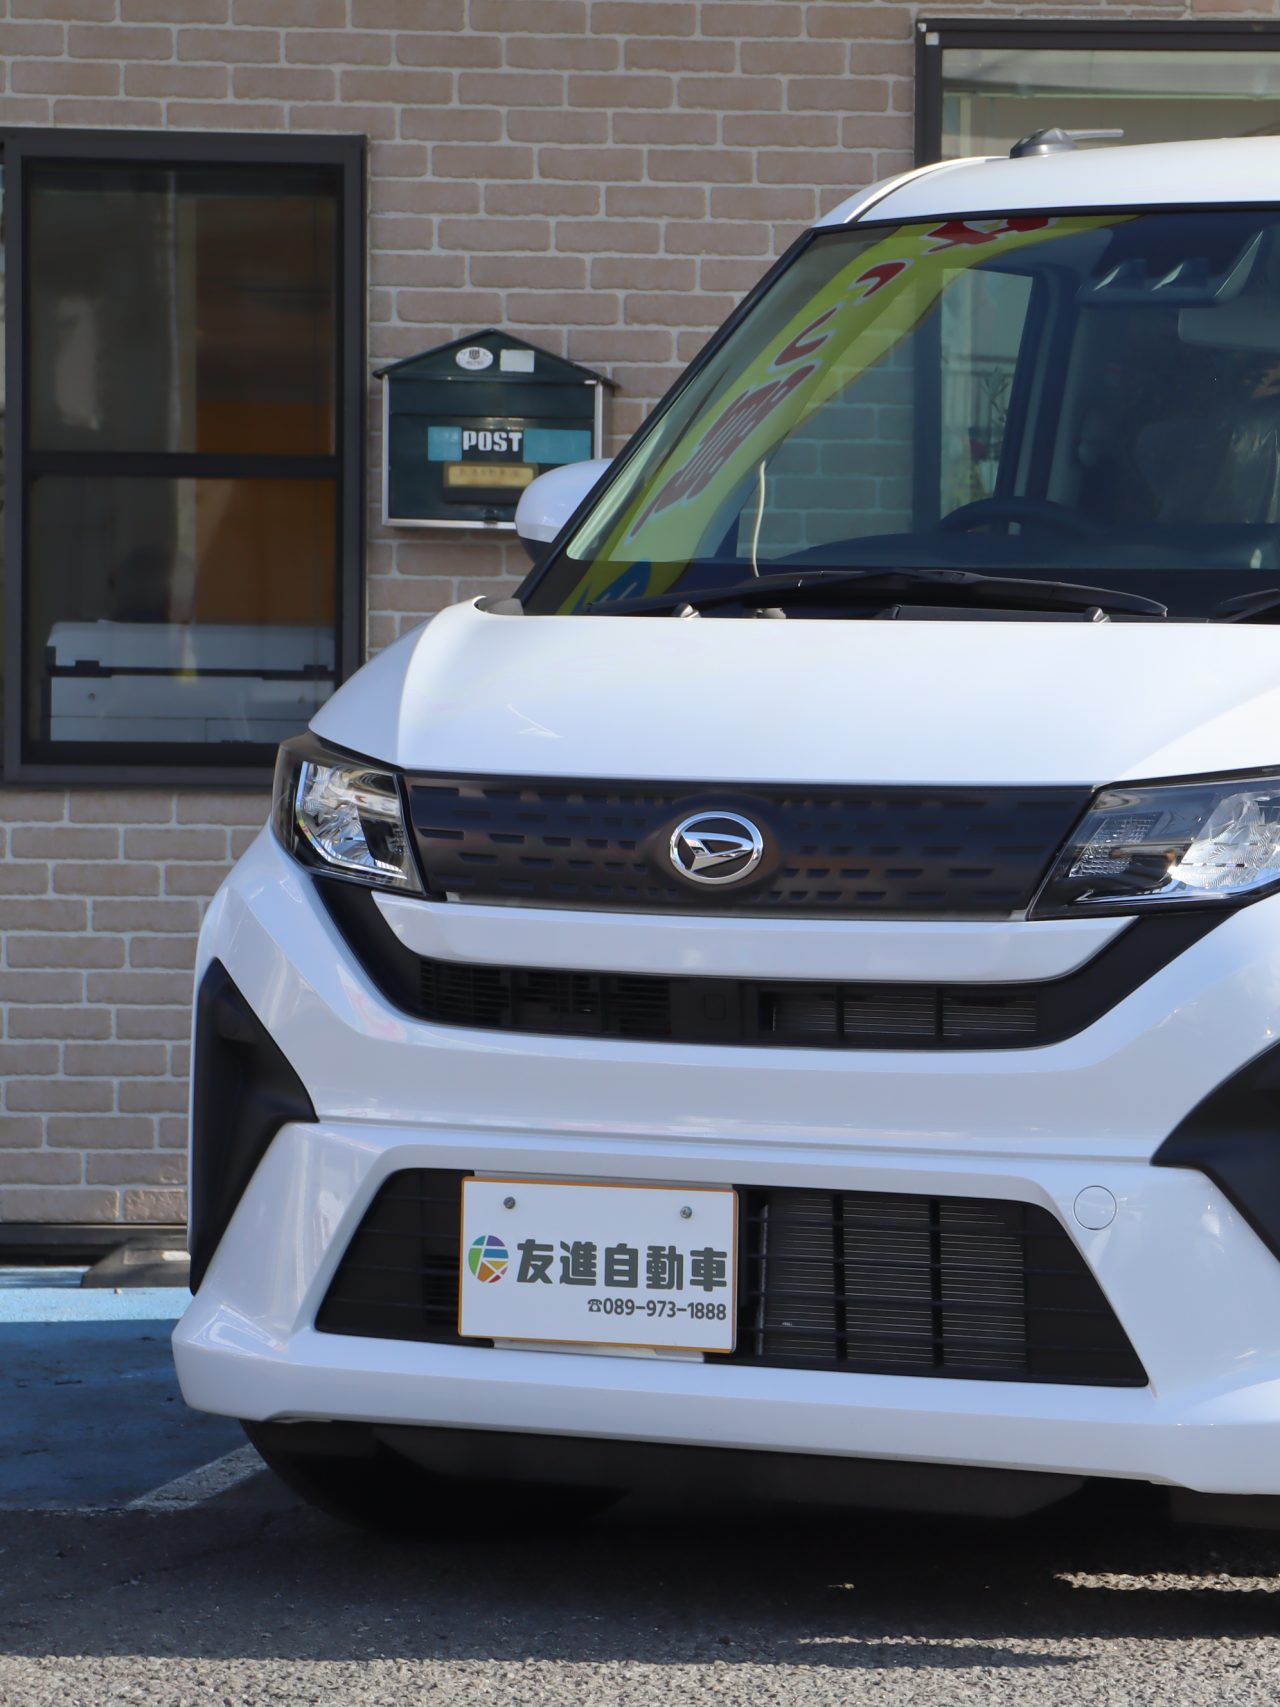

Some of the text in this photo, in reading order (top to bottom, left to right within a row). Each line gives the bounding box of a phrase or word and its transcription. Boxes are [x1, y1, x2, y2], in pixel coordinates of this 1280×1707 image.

[462, 431, 522, 452] POST
[516, 1238, 728, 1292] 友進自動車
